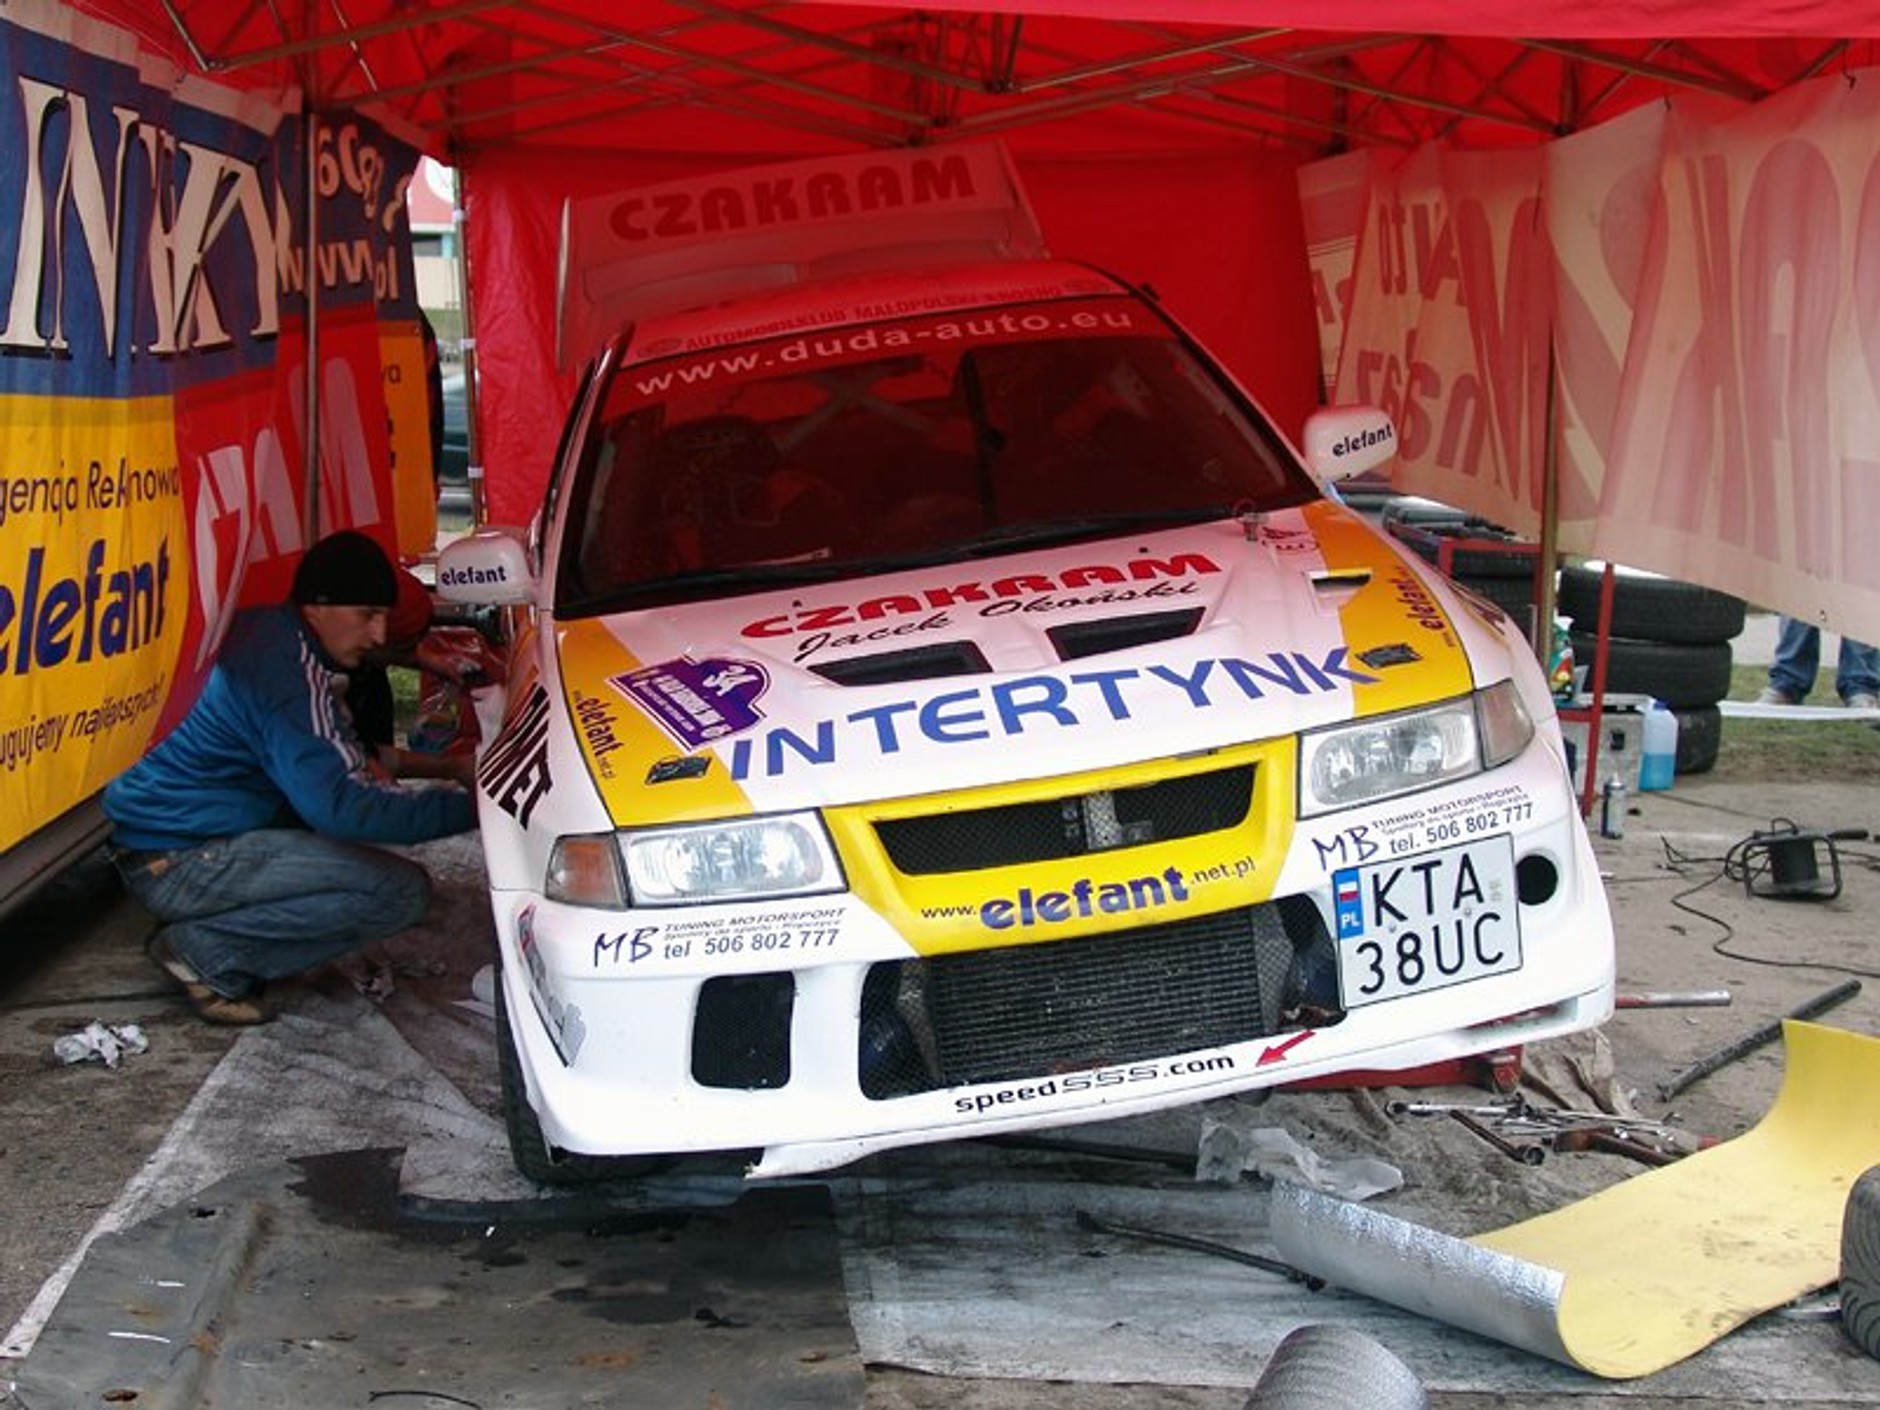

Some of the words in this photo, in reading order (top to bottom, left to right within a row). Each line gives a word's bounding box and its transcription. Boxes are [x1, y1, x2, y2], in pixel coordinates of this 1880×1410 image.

[607, 153, 976, 242] CZAKRAM
[633, 311, 1132, 396] www.duda-auto.eu
[1332, 422, 1393, 458] elefant
[440, 565, 507, 588] elefant
[740, 552, 1222, 640] CZAKRAM
[793, 610, 954, 665] Jacek
[730, 645, 1385, 782] INTERTYNK
[1311, 824, 1379, 871] MB
[1389, 832, 1421, 854] tel.
[1426, 822, 1461, 844] 506
[1465, 810, 1499, 834] 802
[1502, 801, 1534, 824] 777
[1371, 852, 1484, 927] KTA
[593, 926, 660, 968] MB
[703, 936, 744, 956] 506
[751, 931, 792, 952] 802
[800, 928, 840, 948] 777
[1340, 913, 1360, 929] PL
[1355, 911, 1504, 995] 38UC
